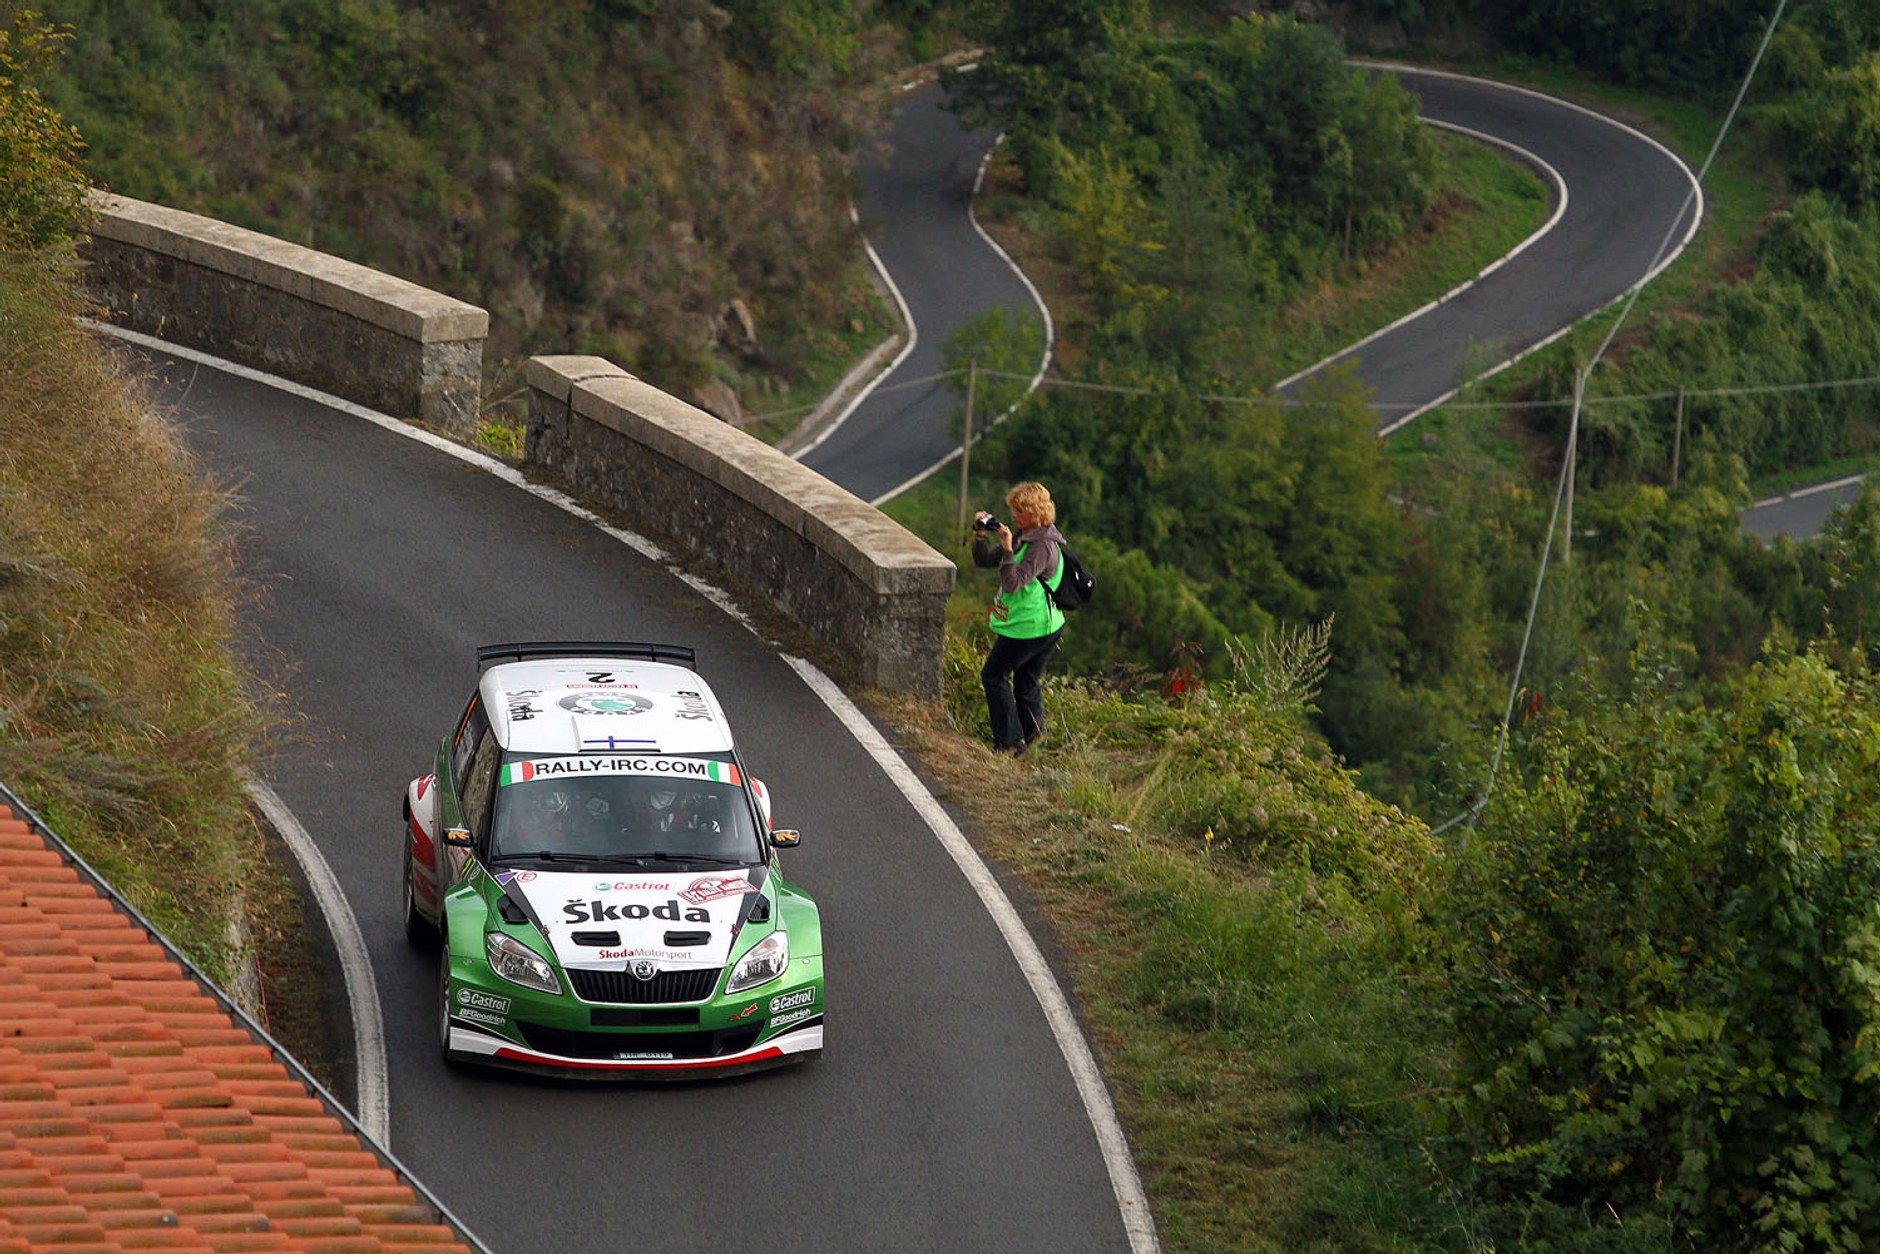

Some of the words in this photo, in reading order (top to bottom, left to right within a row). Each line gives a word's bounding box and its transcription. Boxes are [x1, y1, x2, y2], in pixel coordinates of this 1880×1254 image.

[585, 671, 616, 683] 2
[535, 758, 706, 776] RALLY-IRC.COM
[613, 881, 670, 892] Castrol
[563, 898, 712, 925] Škoda
[471, 993, 507, 1012] Castrol
[780, 989, 812, 1009] Castrol
[459, 1008, 506, 1025] BFGoodrich
